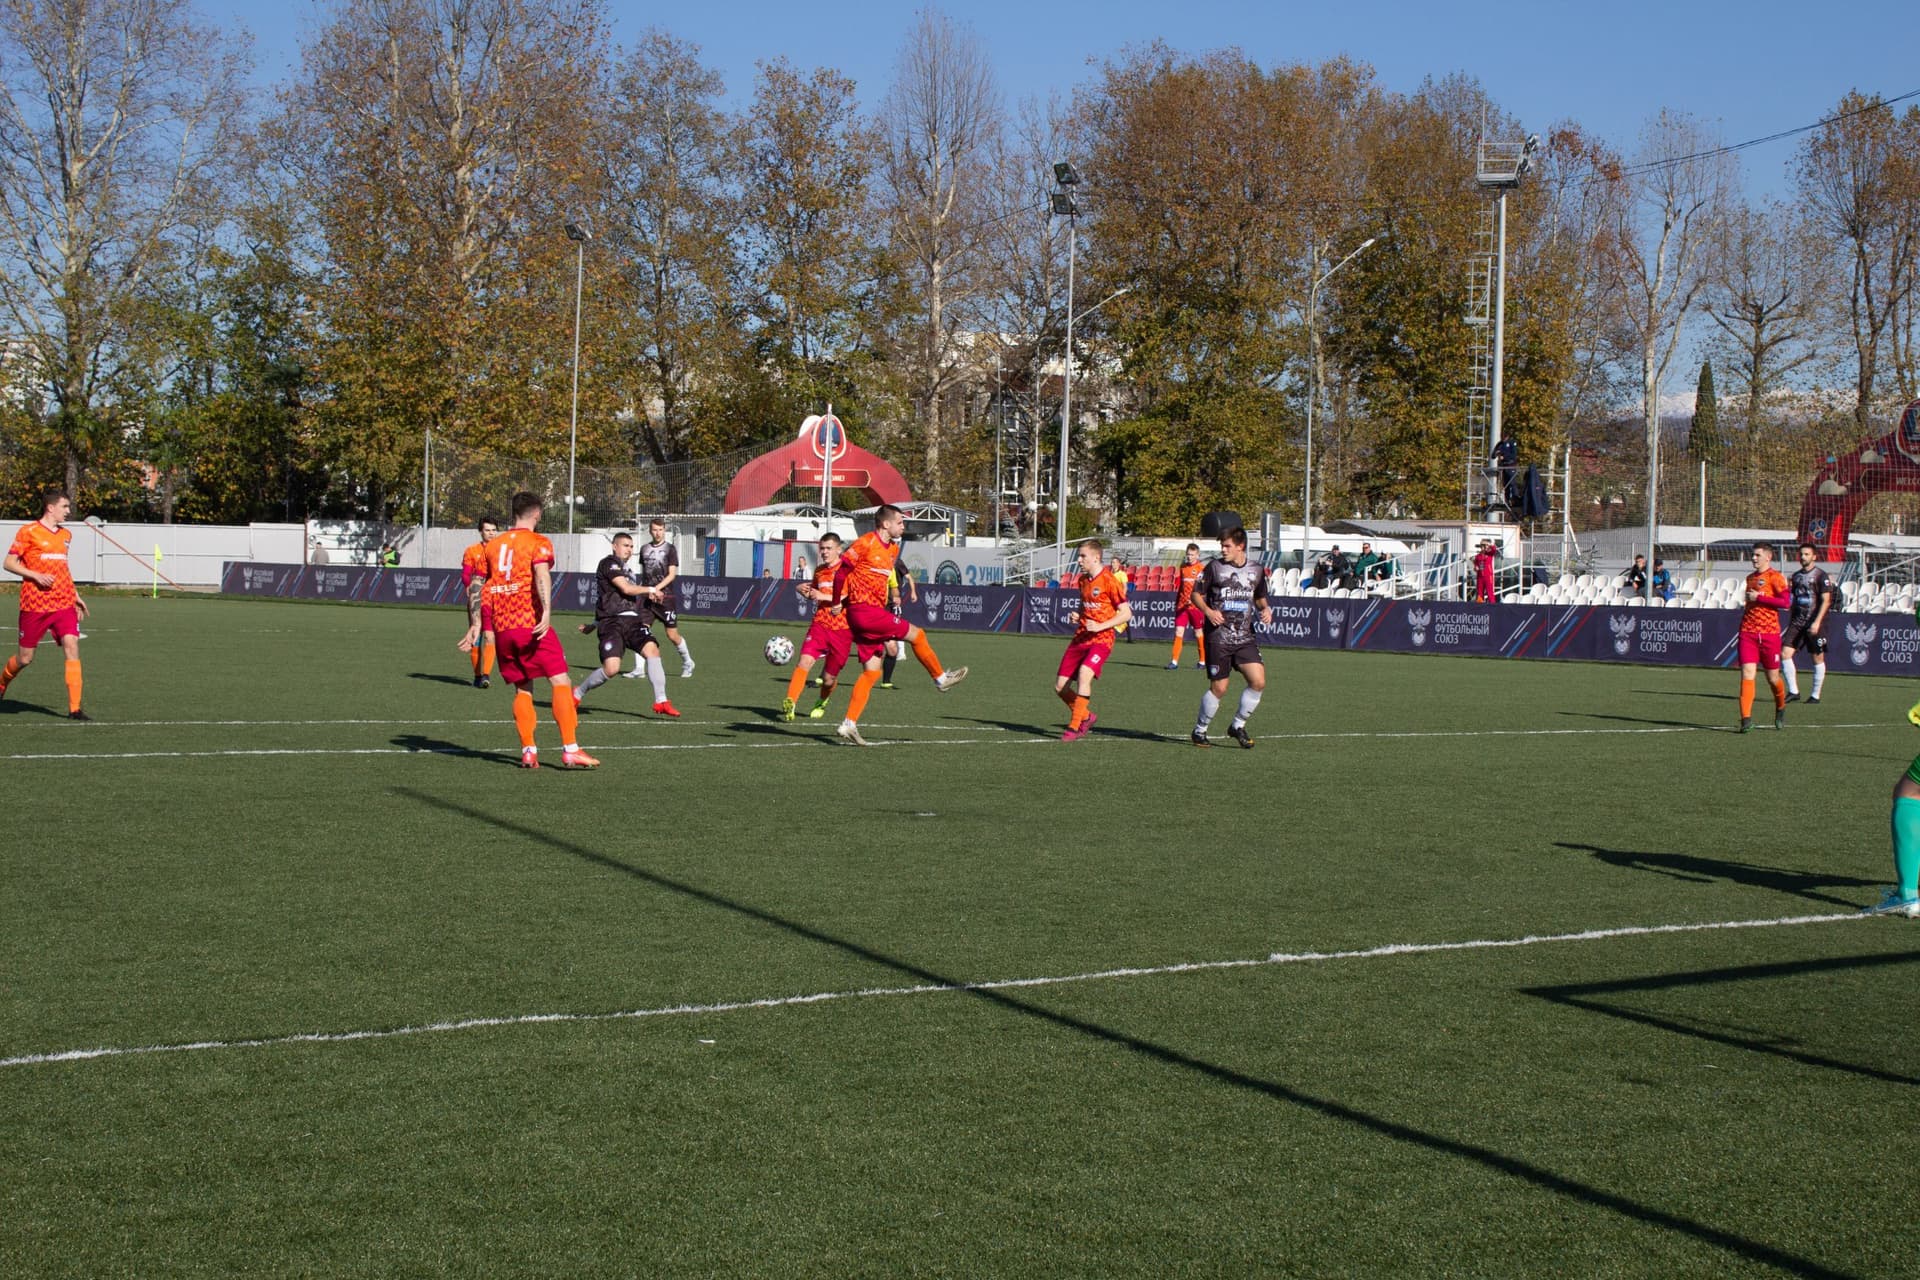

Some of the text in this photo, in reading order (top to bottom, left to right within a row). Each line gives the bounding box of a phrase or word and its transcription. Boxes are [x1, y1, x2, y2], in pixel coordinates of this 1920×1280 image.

[498, 543, 514, 581] 4
[1268, 606, 1312, 619] УТБОЛУ
[1435, 613, 1490, 625] РОССИЙСКИЙ
[1434, 623, 1490, 636] ФУТБОЛЬНЫЙ
[1640, 619, 1703, 632] РОССИЙСКИЙ
[1434, 634, 1459, 644] СОЮЗ
[1640, 631, 1703, 643] ФУТБОЛЬНЫЙ
[1640, 641, 1668, 653] СОЮЗ
[1880, 651, 1913, 664] СОЮЗ
